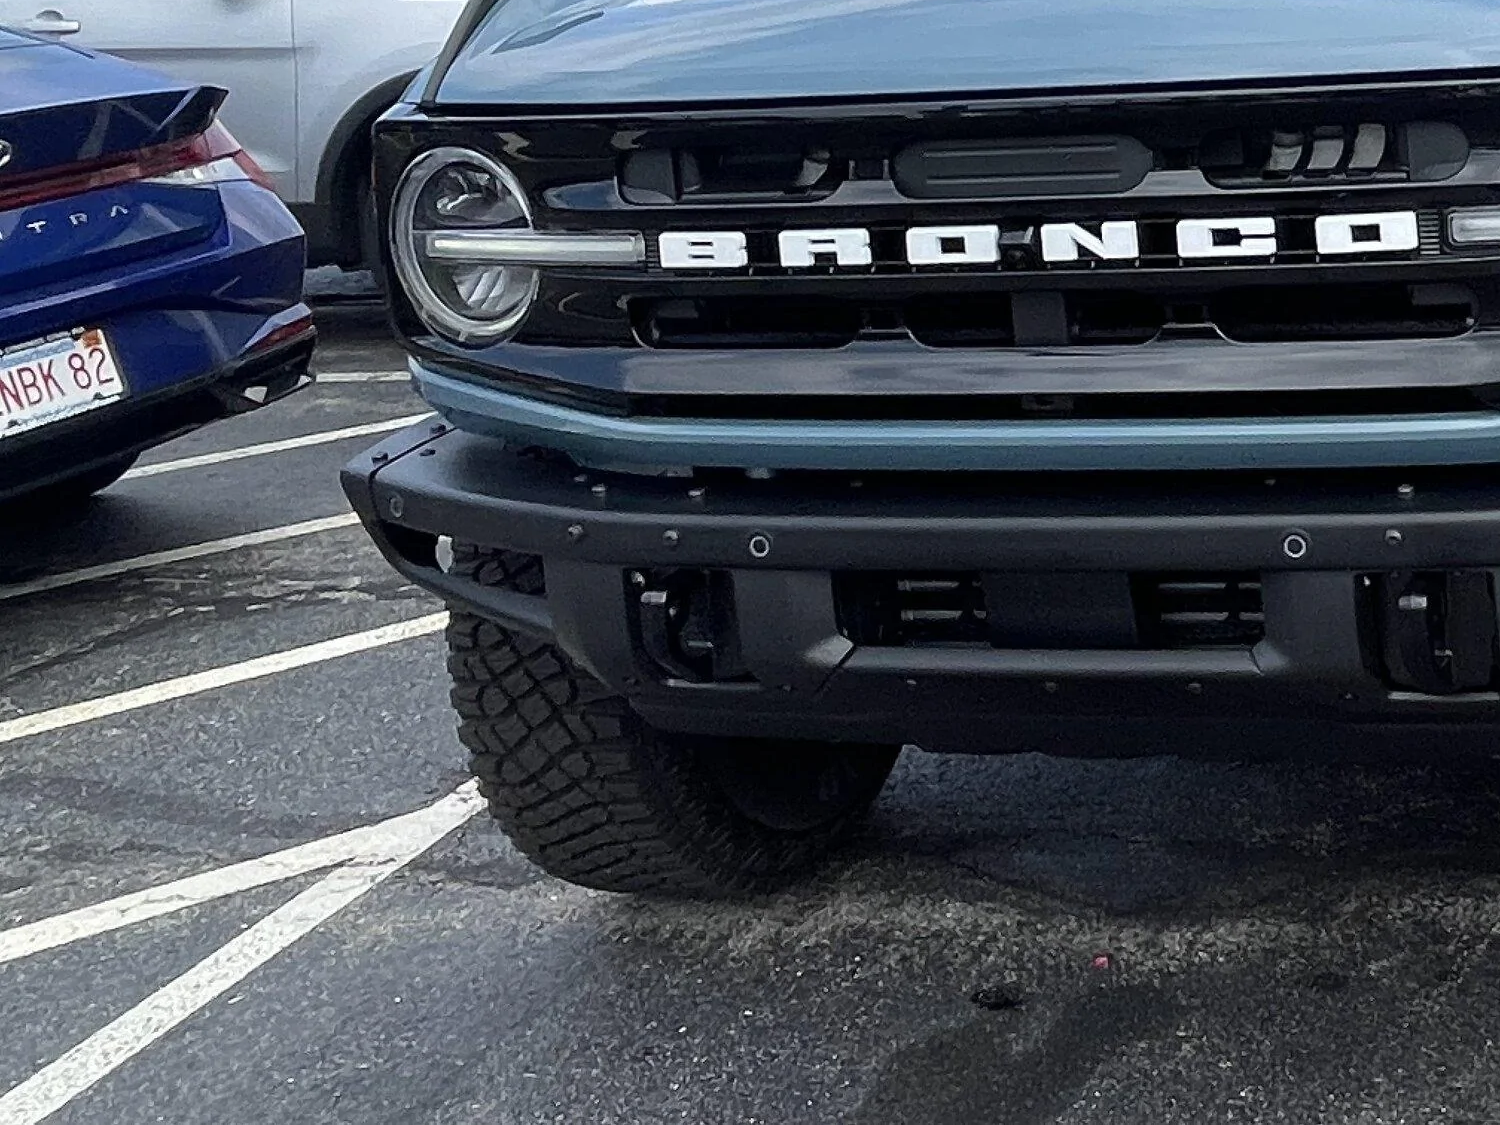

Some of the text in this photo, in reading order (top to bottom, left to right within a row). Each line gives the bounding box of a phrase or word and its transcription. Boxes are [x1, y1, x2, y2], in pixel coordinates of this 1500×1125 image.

[0, 205, 129, 239] TRA
[657, 210, 1420, 271] BRONCO
[68, 348, 114, 390] 82
